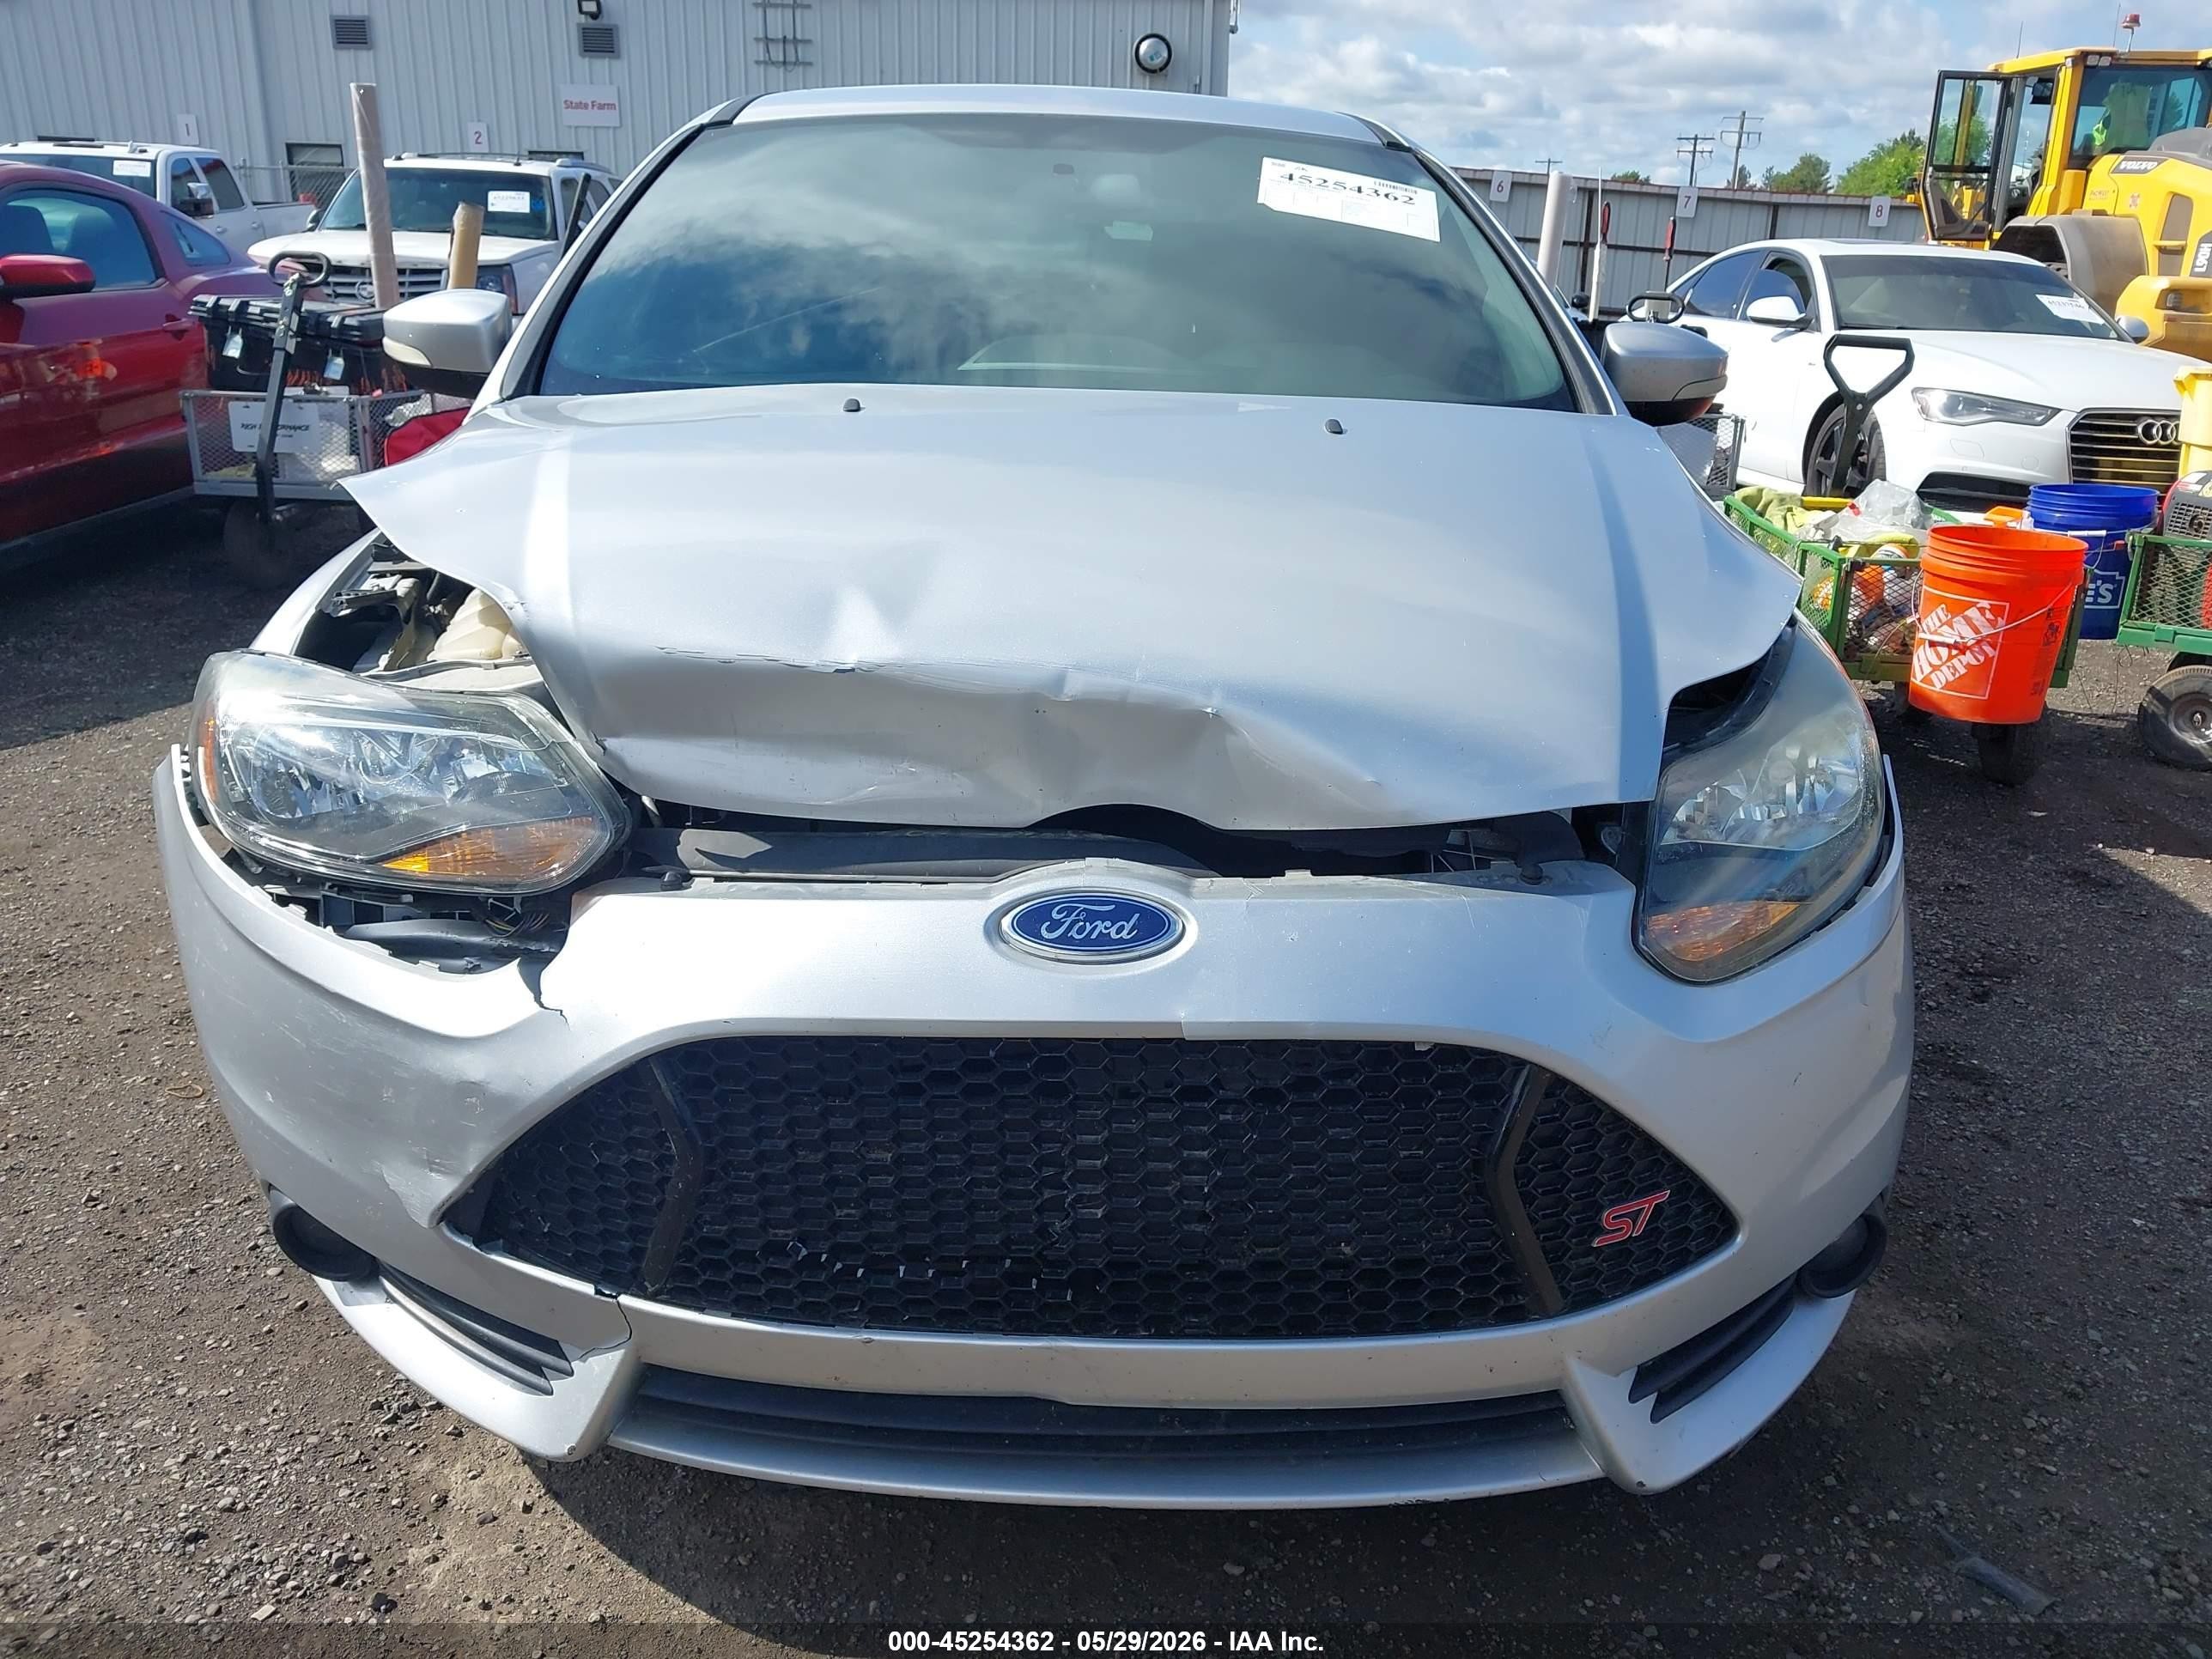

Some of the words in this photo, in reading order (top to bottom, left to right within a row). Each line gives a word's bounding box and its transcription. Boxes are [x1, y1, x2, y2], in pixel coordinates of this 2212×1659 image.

[562, 100, 589, 111] State
[591, 100, 617, 111] Farm
[185, 123, 191, 137] 1
[473, 131, 483, 145] 2
[2118, 161, 2159, 171] VOLVO
[1279, 173, 1416, 206] 45254362
[1497, 179, 1504, 193] 6
[1684, 196, 1692, 209] 7
[1875, 204, 1884, 218] 8
[1913, 602, 2005, 682] HOME
[1929, 641, 1996, 690] DEPOT
[1041, 903, 1140, 940] Ford
[1591, 1189, 1670, 1248] ST
